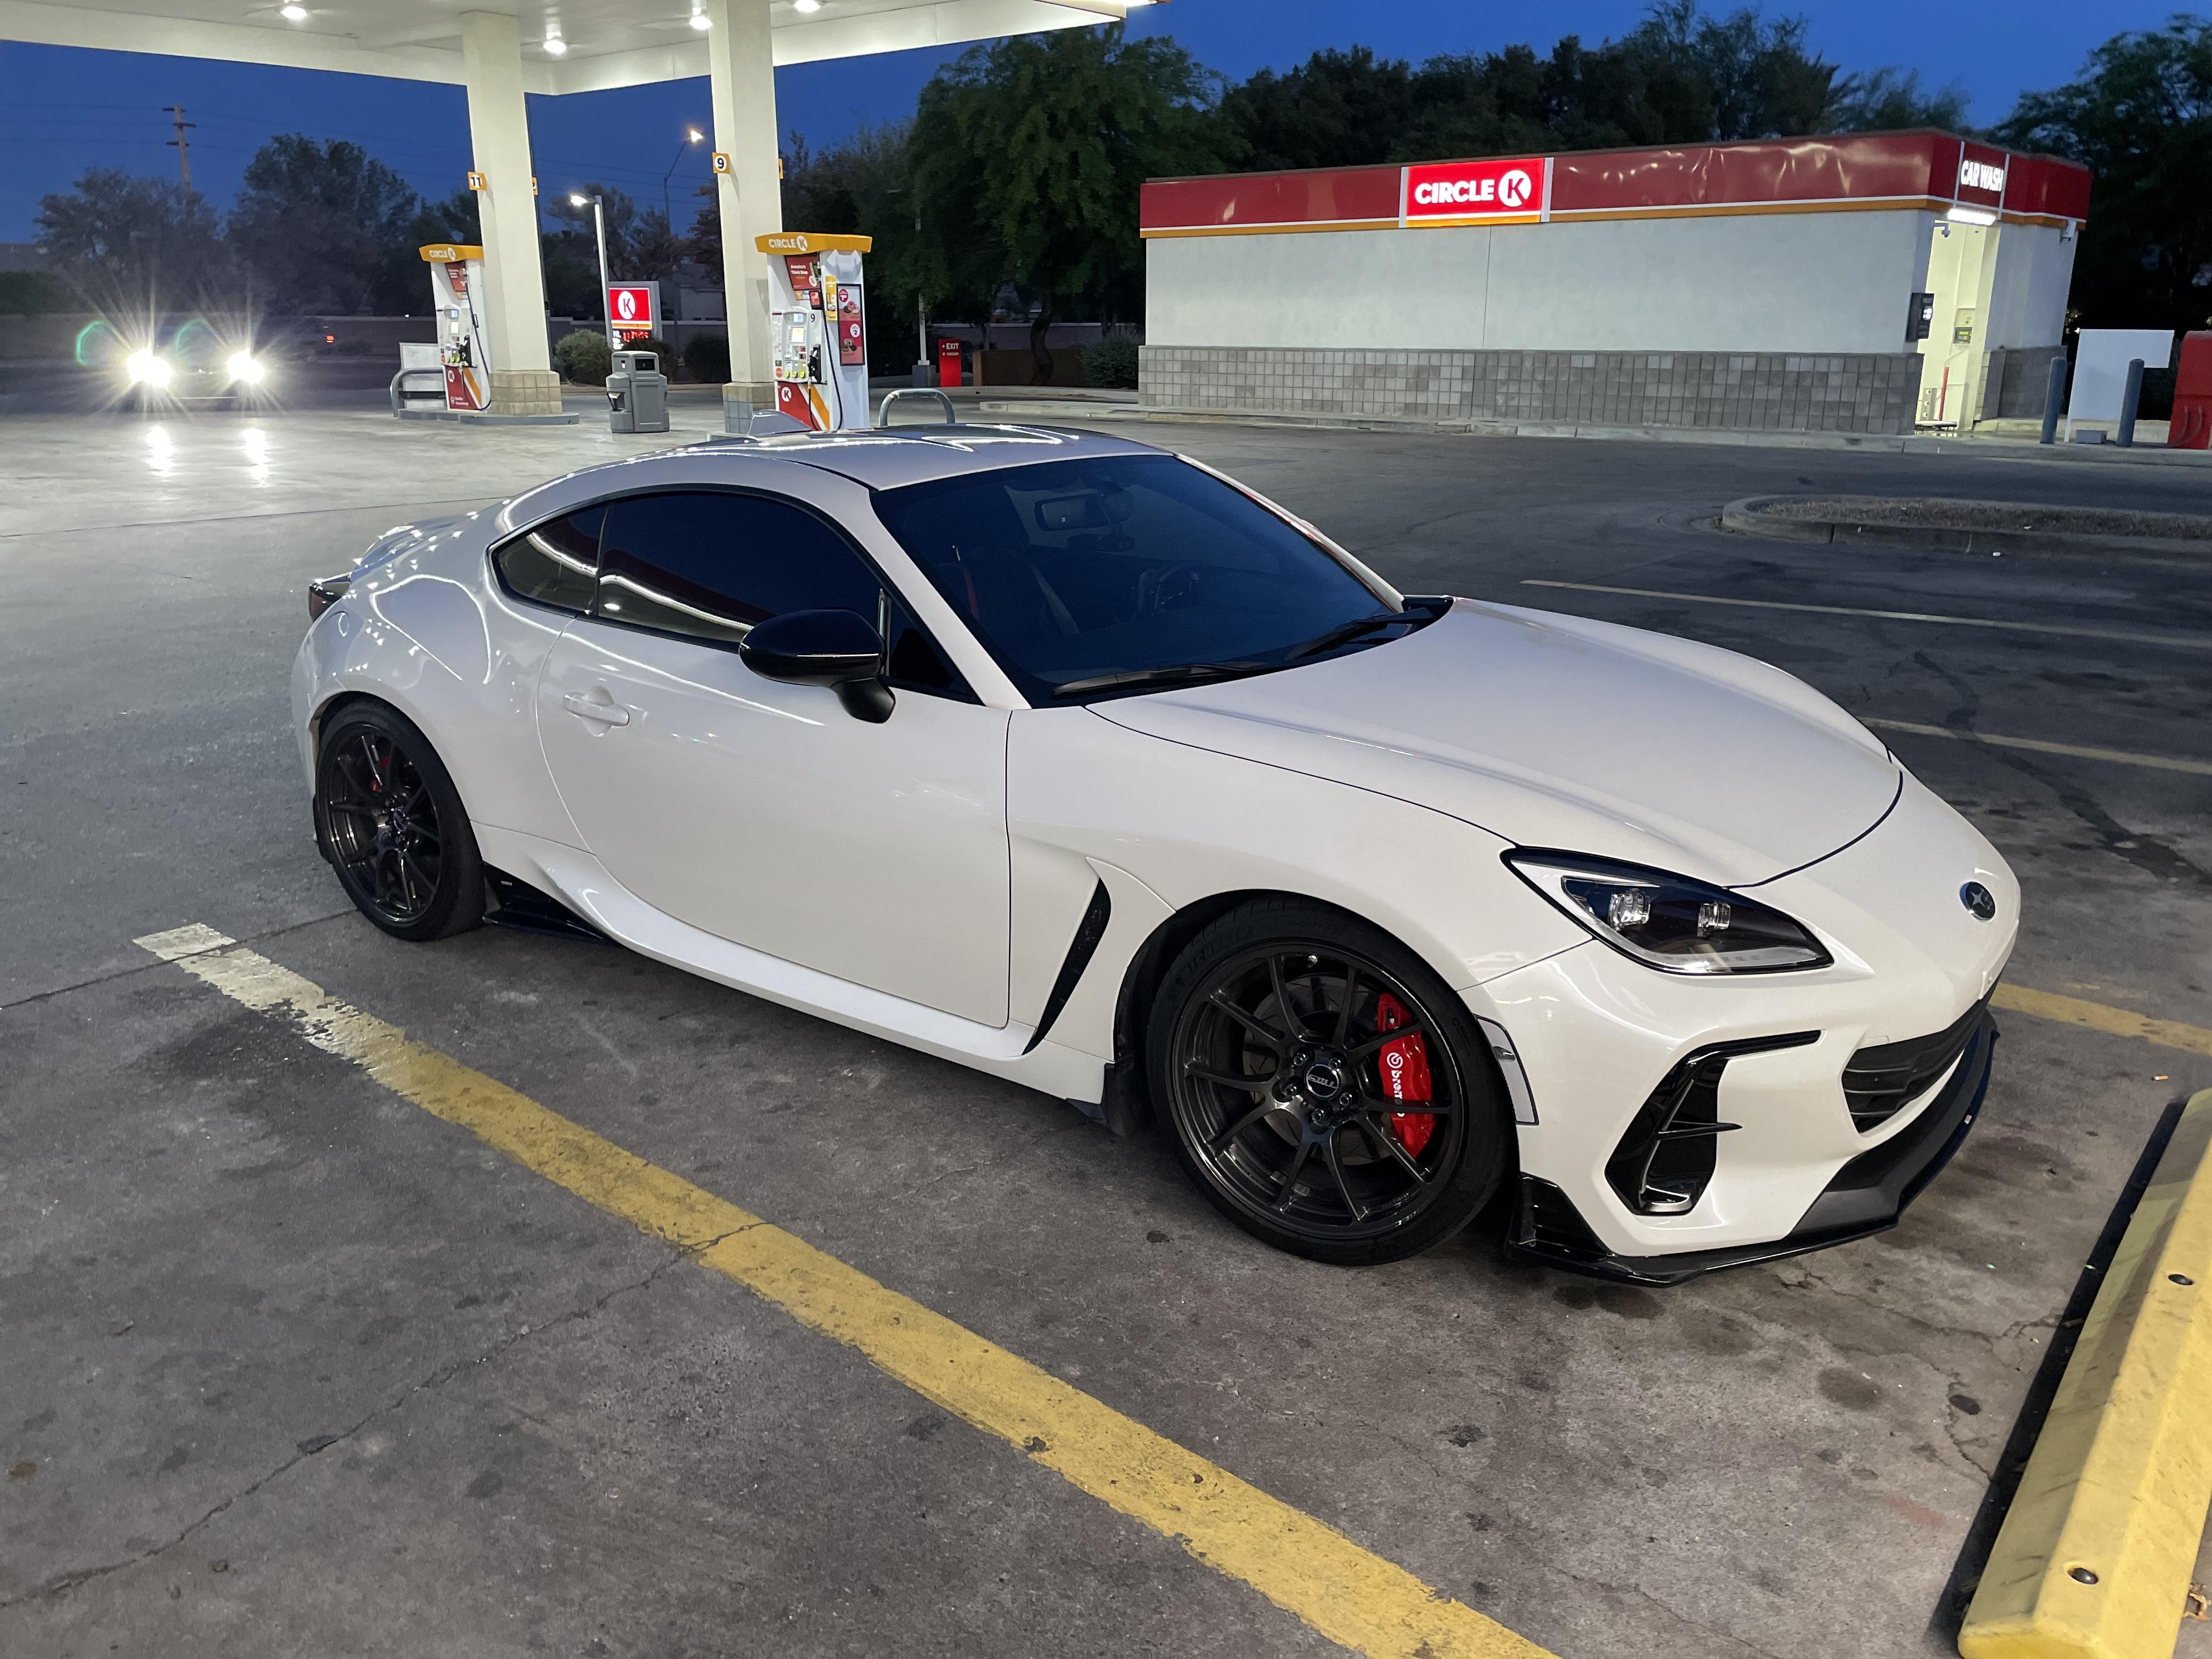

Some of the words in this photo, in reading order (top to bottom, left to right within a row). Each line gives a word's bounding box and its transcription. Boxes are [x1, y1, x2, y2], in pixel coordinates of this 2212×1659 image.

[718, 157, 724, 169] 9
[1961, 160, 1980, 187] CAR
[1980, 165, 2004, 191] WASH
[471, 177, 482, 187] 11
[1414, 179, 1495, 205] CIRCLE
[769, 238, 797, 249] CIRCLE
[810, 313, 815, 323] 9
[1391, 1070, 1405, 1118] bremo
